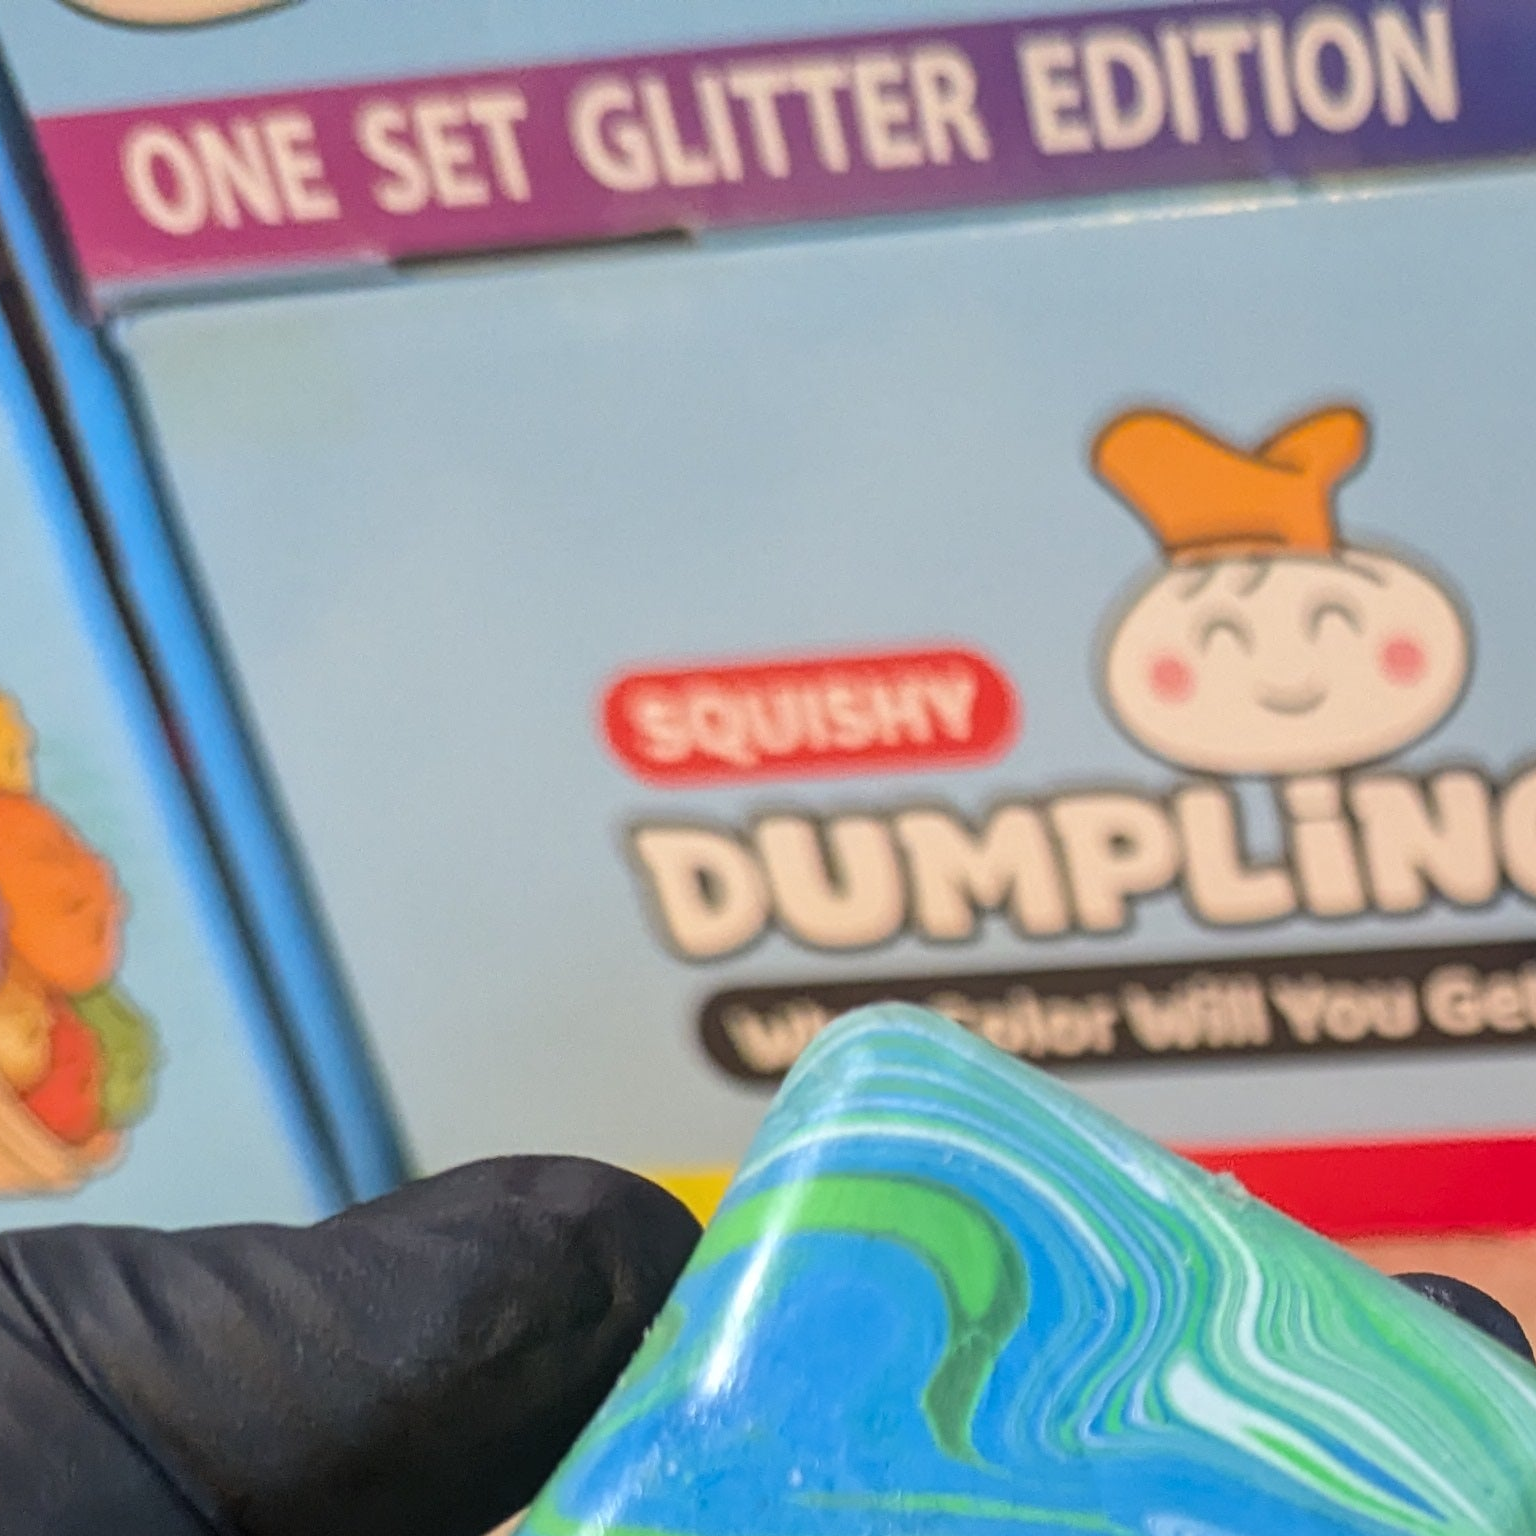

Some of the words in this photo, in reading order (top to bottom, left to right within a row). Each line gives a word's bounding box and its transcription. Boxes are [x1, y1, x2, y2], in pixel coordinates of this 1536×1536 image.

[120, 112, 340, 235] ONE
[354, 94, 532, 214] SET
[567, 43, 992, 192] GLITTER
[1020, 6, 1459, 155] EDITION
[628, 675, 978, 766] SQUISHY
[1120, 971, 1272, 1052] Will
[1268, 970, 1420, 1042] You
